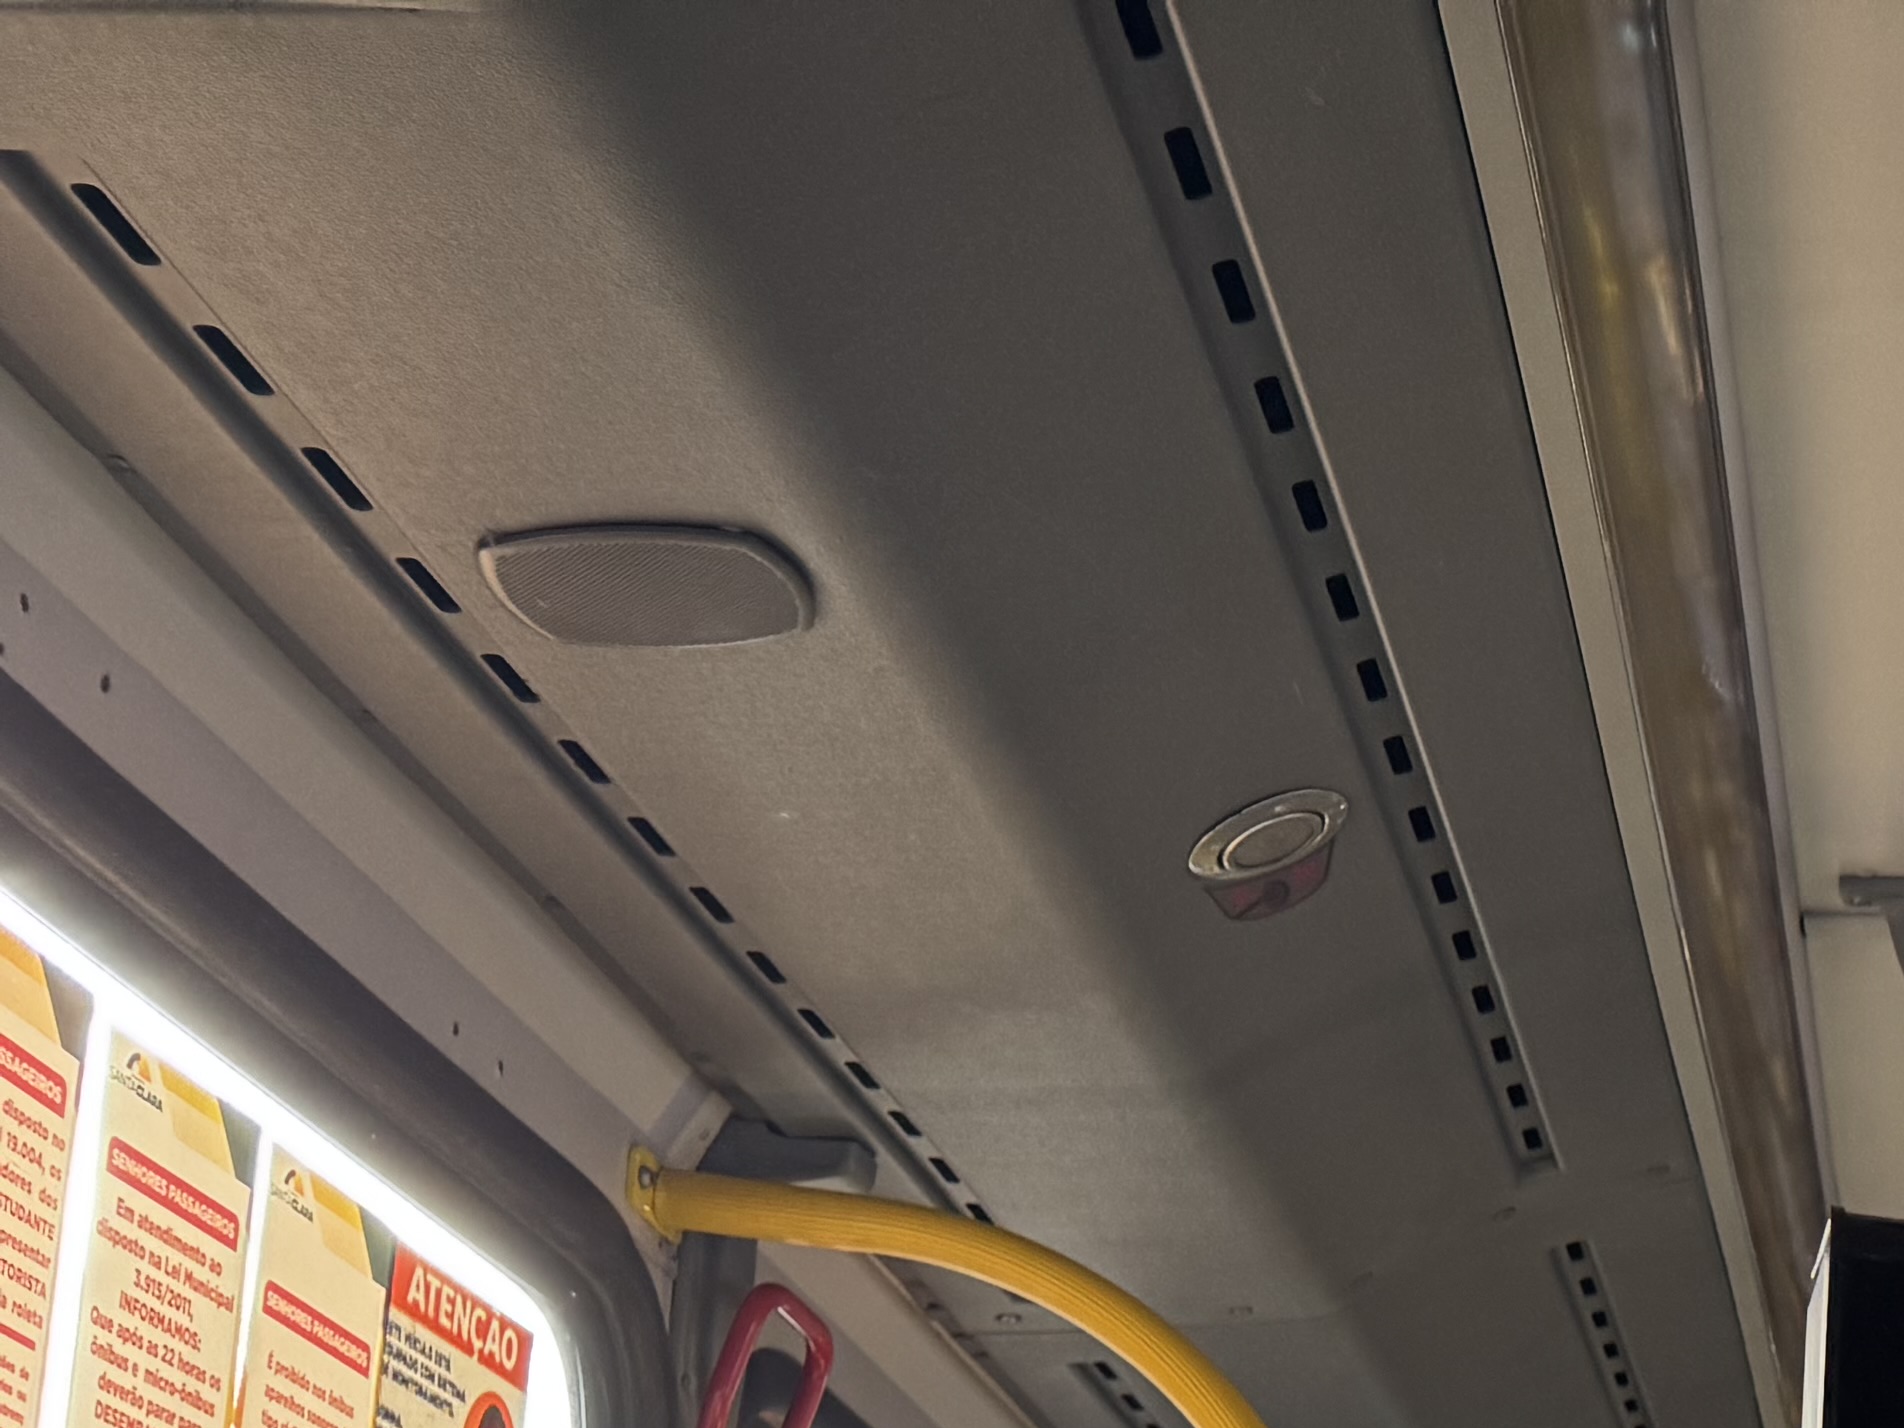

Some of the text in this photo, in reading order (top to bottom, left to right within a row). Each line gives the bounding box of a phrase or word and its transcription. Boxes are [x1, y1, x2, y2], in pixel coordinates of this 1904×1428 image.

[2, 1098, 48, 1140] disposto
[110, 1147, 234, 1238] SENHORES PASSAGEIROS
[97, 1218, 234, 1312] disposto na Lei Municipal
[115, 1196, 222, 1277] Em atendimento ao
[90, 1305, 221, 1392] Que após as 22 horas os
[119, 1291, 200, 1351] INFORMAMOS:
[266, 1290, 367, 1367] SENHORES PASSAGEIROS
[407, 1263, 519, 1371] ATENÇÃO
[90, 1335, 129, 1372] ônibus
[143, 1368, 215, 1417] micro-ônibus
[97, 1372, 144, 1410] deverão
[145, 1399, 176, 1426] parar
